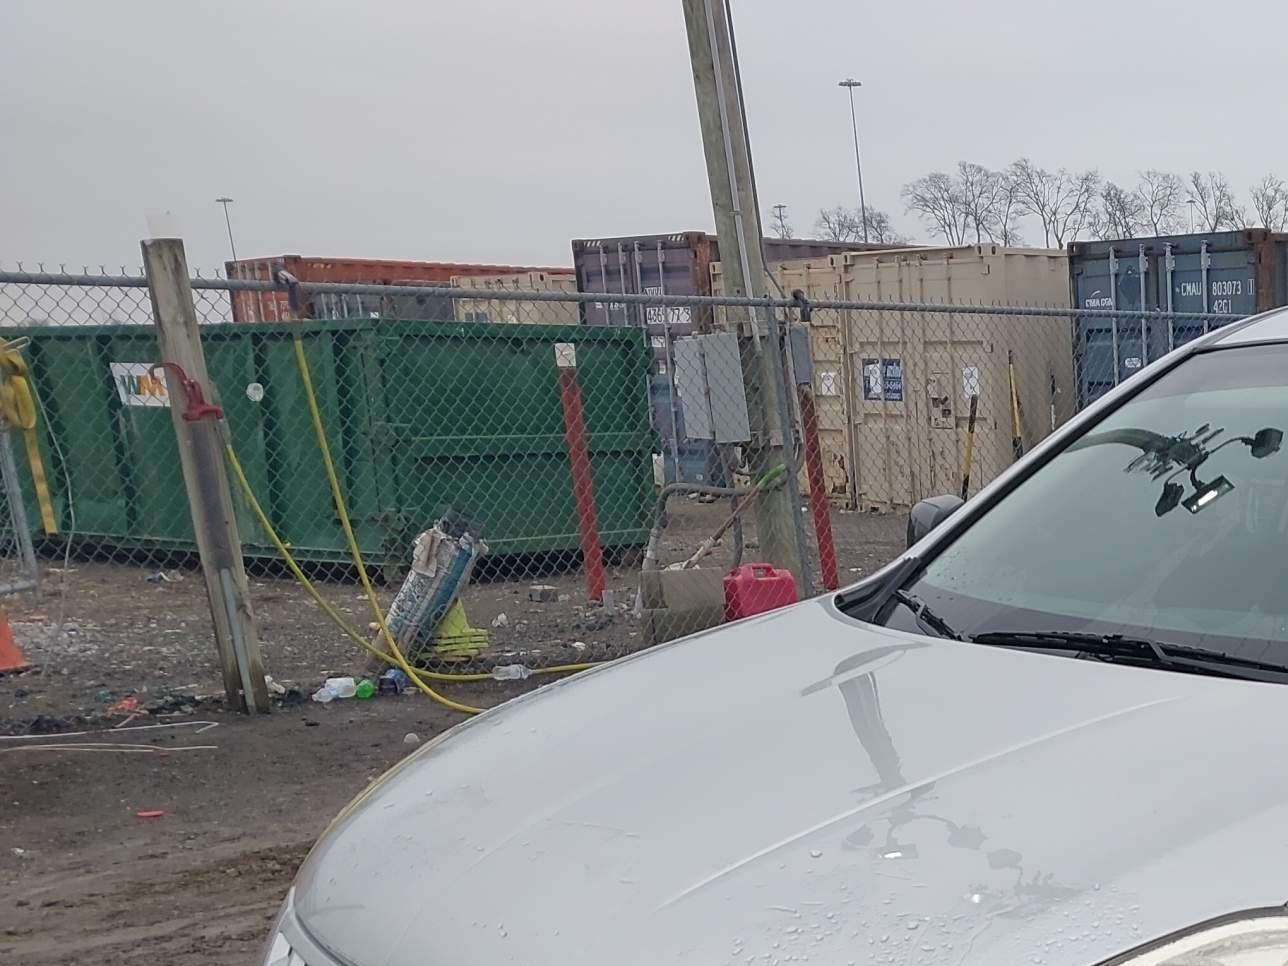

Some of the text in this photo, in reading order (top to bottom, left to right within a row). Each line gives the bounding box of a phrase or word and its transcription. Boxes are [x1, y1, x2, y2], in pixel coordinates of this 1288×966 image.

[1181, 281, 1202, 297] CMAU
[1212, 280, 1242, 296] 803073
[119, 374, 167, 396] WM
